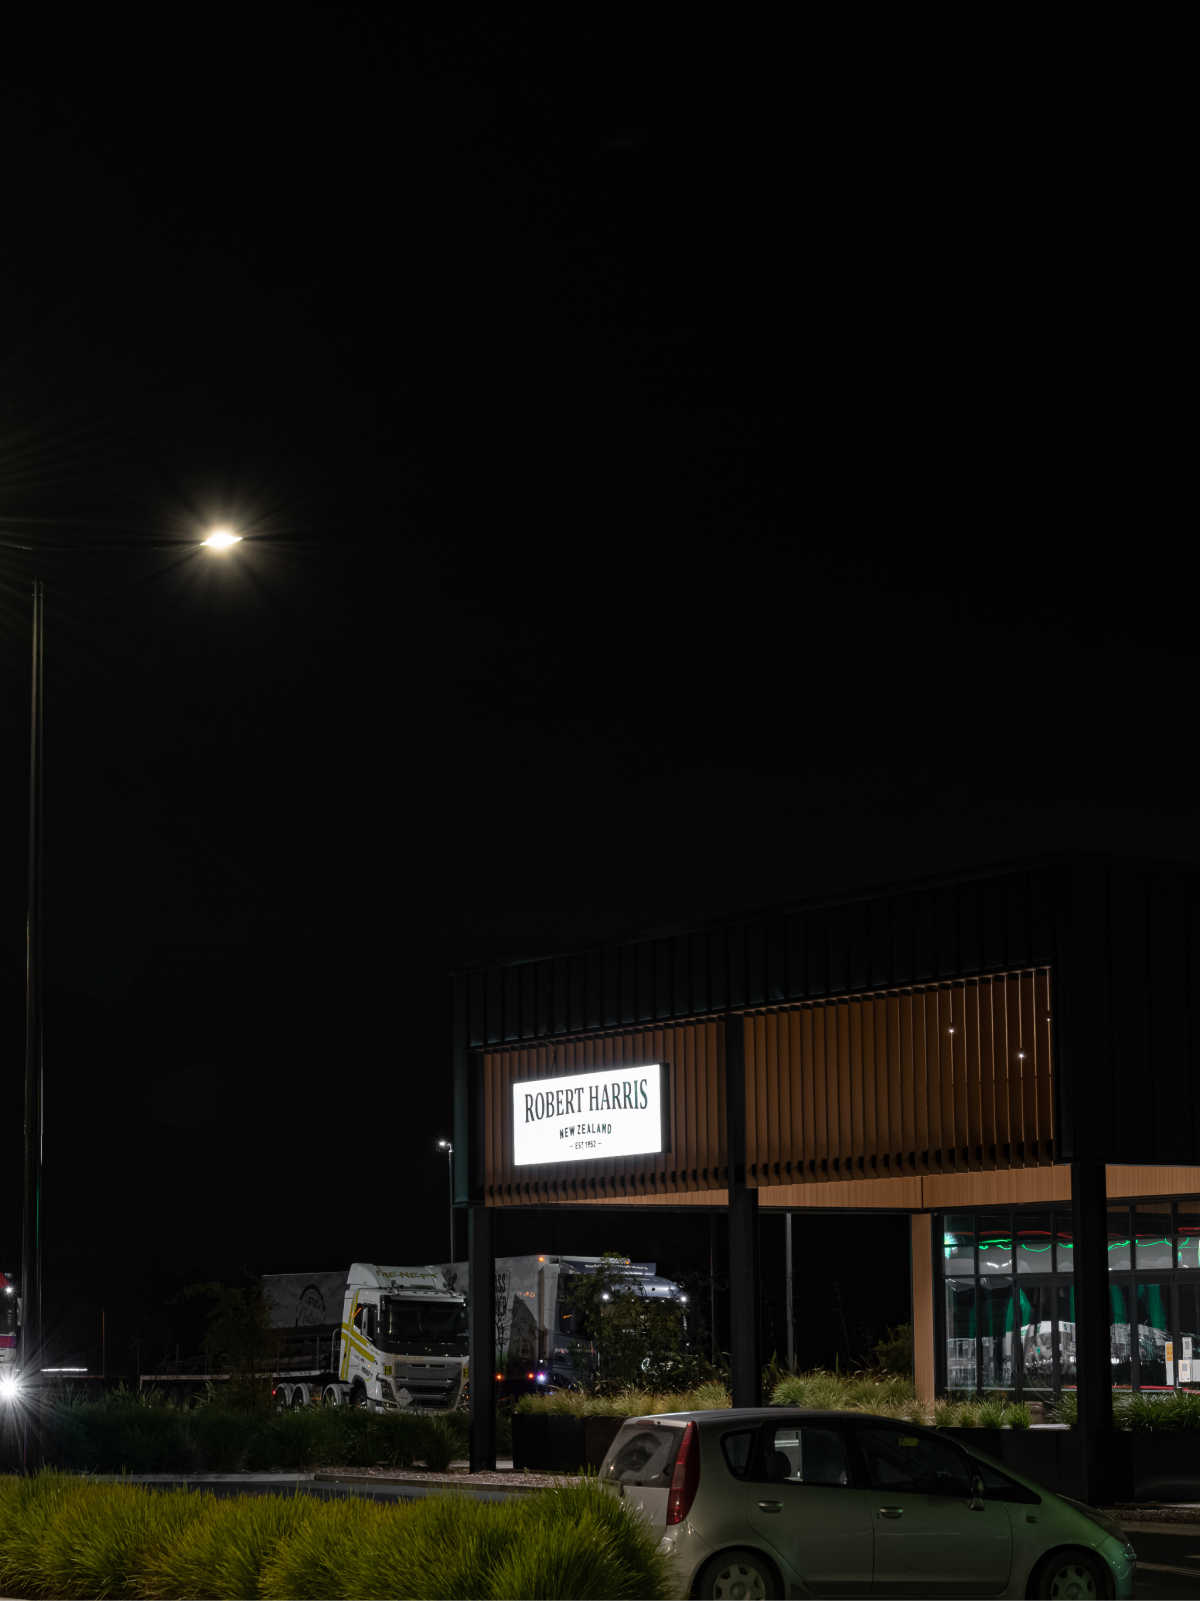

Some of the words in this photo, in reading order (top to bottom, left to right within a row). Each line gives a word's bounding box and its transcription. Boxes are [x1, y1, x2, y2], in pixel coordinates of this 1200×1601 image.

[525, 1087, 584, 1123] ROBERT
[588, 1079, 648, 1111] HARRIS
[559, 1125, 575, 1139] NEW
[577, 1123, 612, 1135] ZEALAND
